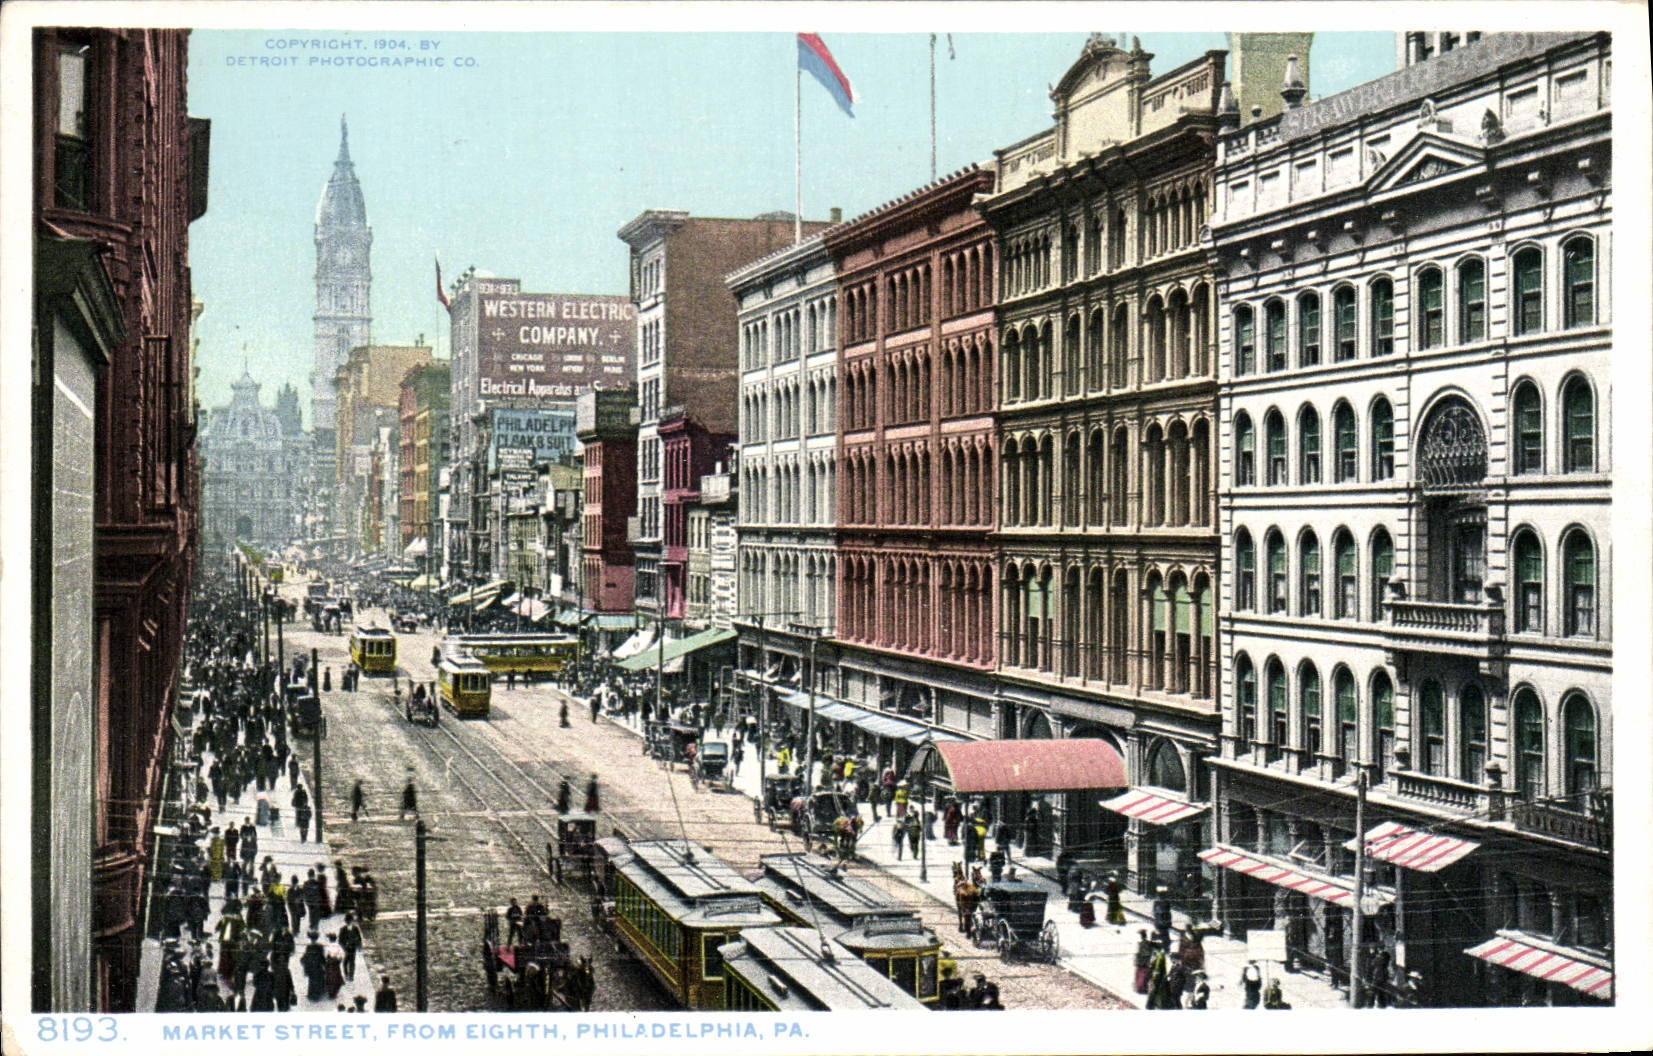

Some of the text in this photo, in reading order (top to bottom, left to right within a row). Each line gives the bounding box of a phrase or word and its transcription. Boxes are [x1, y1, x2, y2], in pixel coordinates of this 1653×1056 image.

[484, 300, 633, 321] WESTERN ELECTRIC
[480, 377, 526, 395] Electrical
[528, 379, 572, 397] Apparatus
[547, 436, 572, 450] SUIT
